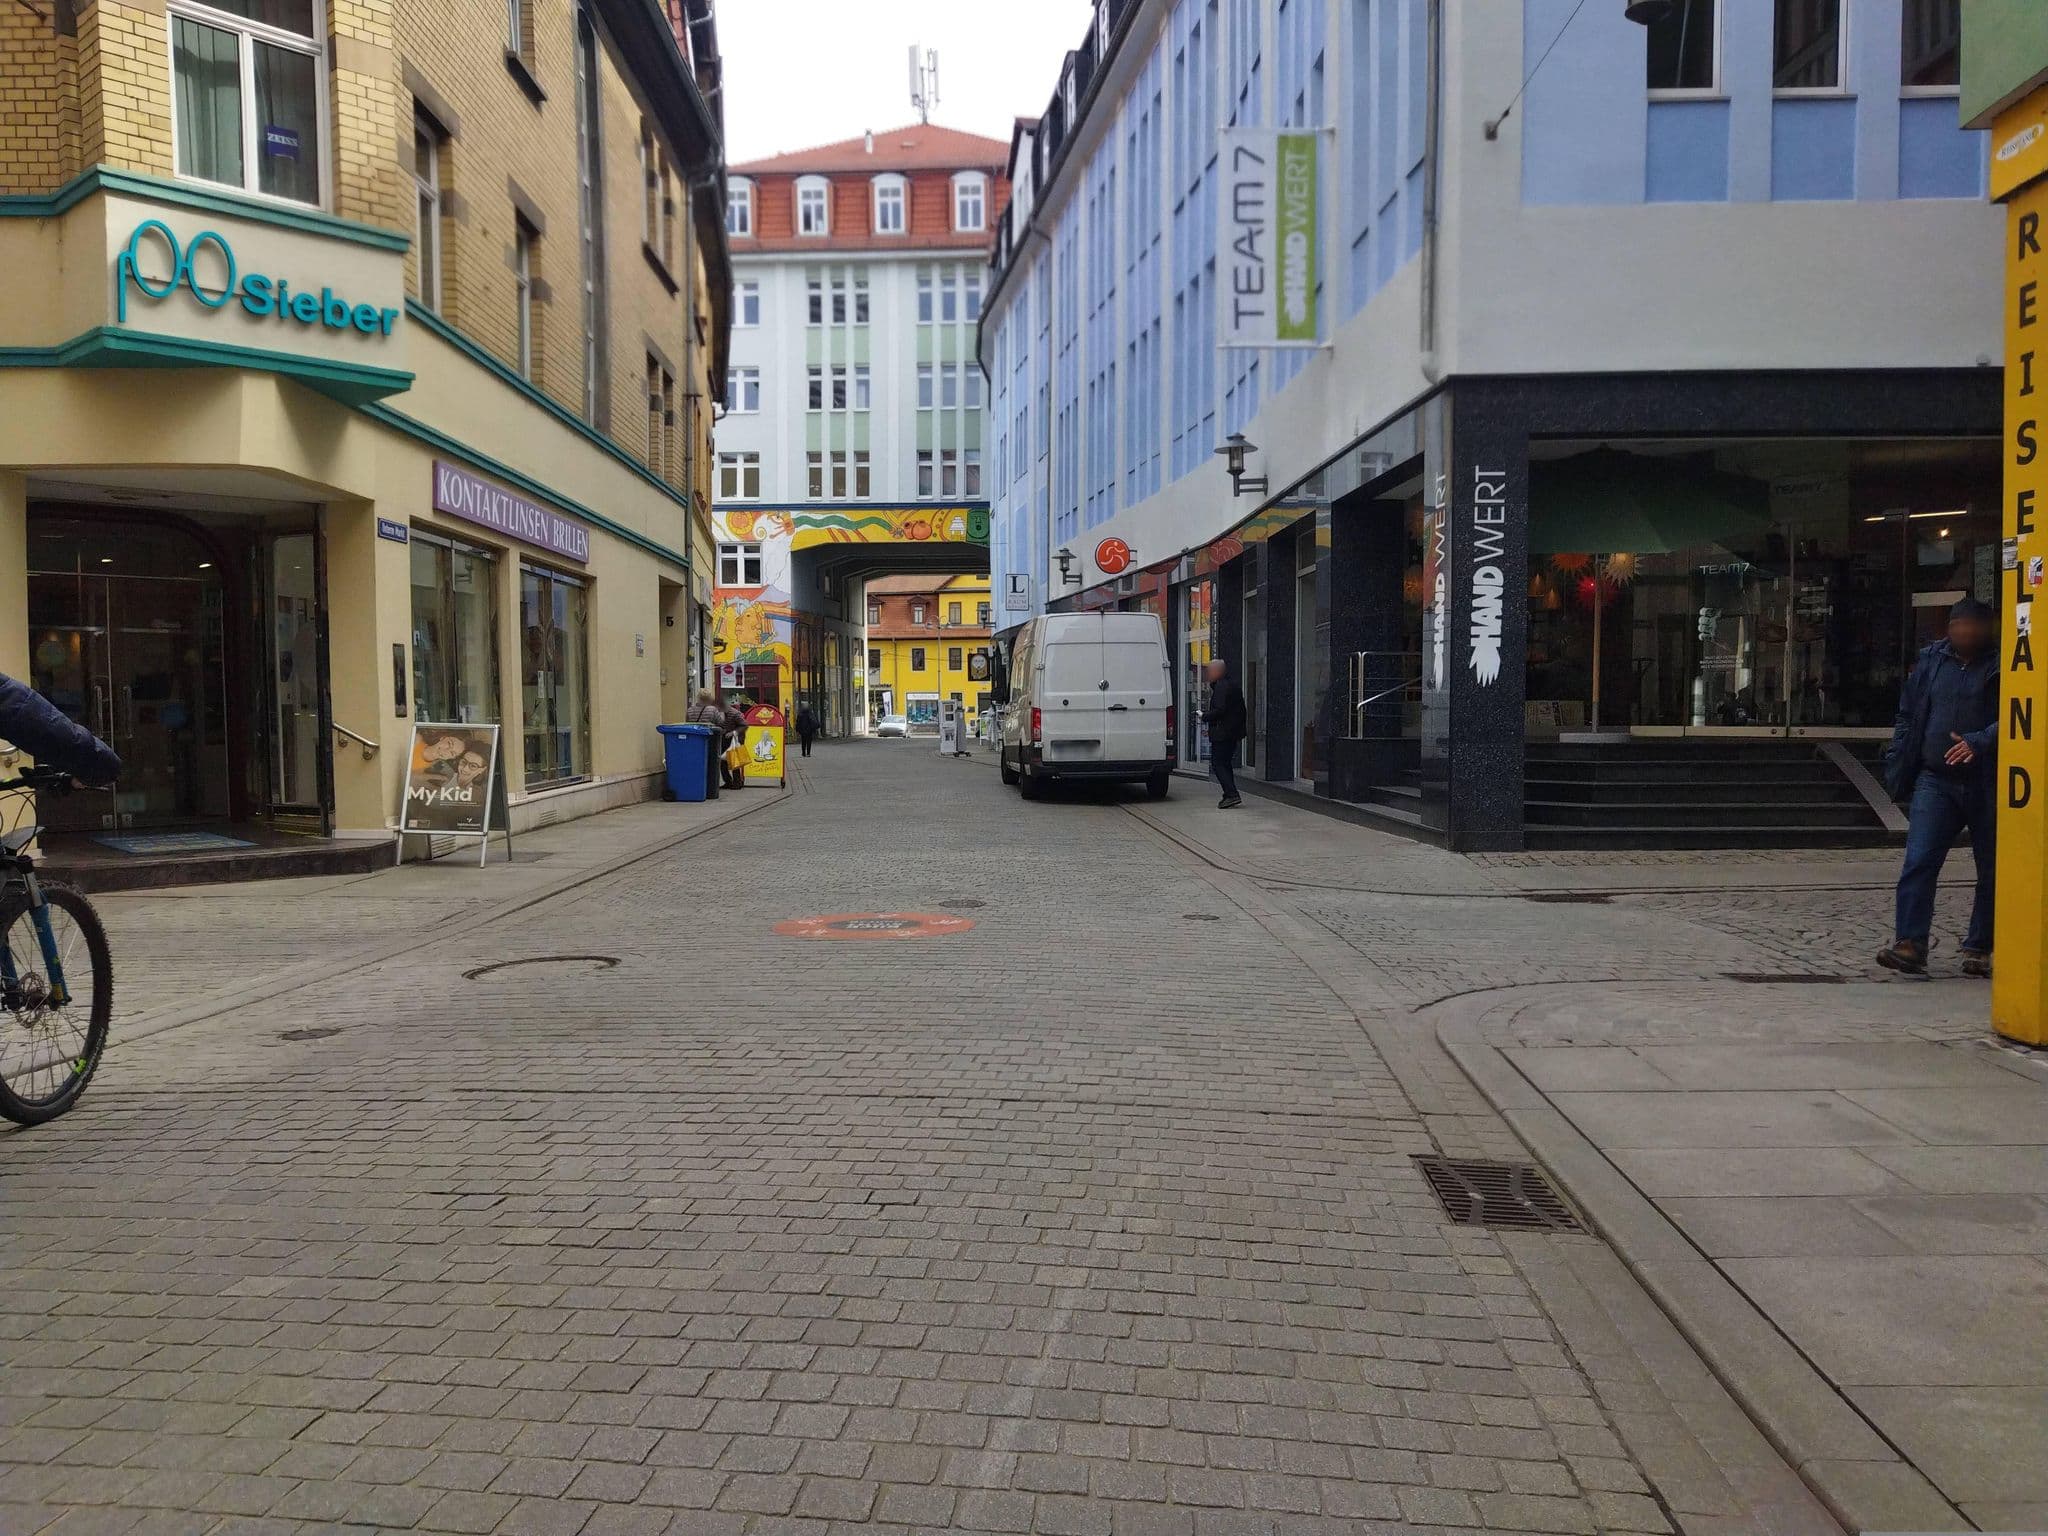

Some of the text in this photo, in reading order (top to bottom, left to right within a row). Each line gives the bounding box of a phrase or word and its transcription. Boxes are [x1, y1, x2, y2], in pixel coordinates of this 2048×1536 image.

[240, 273, 399, 336] Sieber
[440, 467, 588, 558] KONTAKTLINSEN BRILLEN
[1010, 576, 1024, 593] L
[666, 616, 674, 627] 5
[408, 785, 473, 806] My Kid
